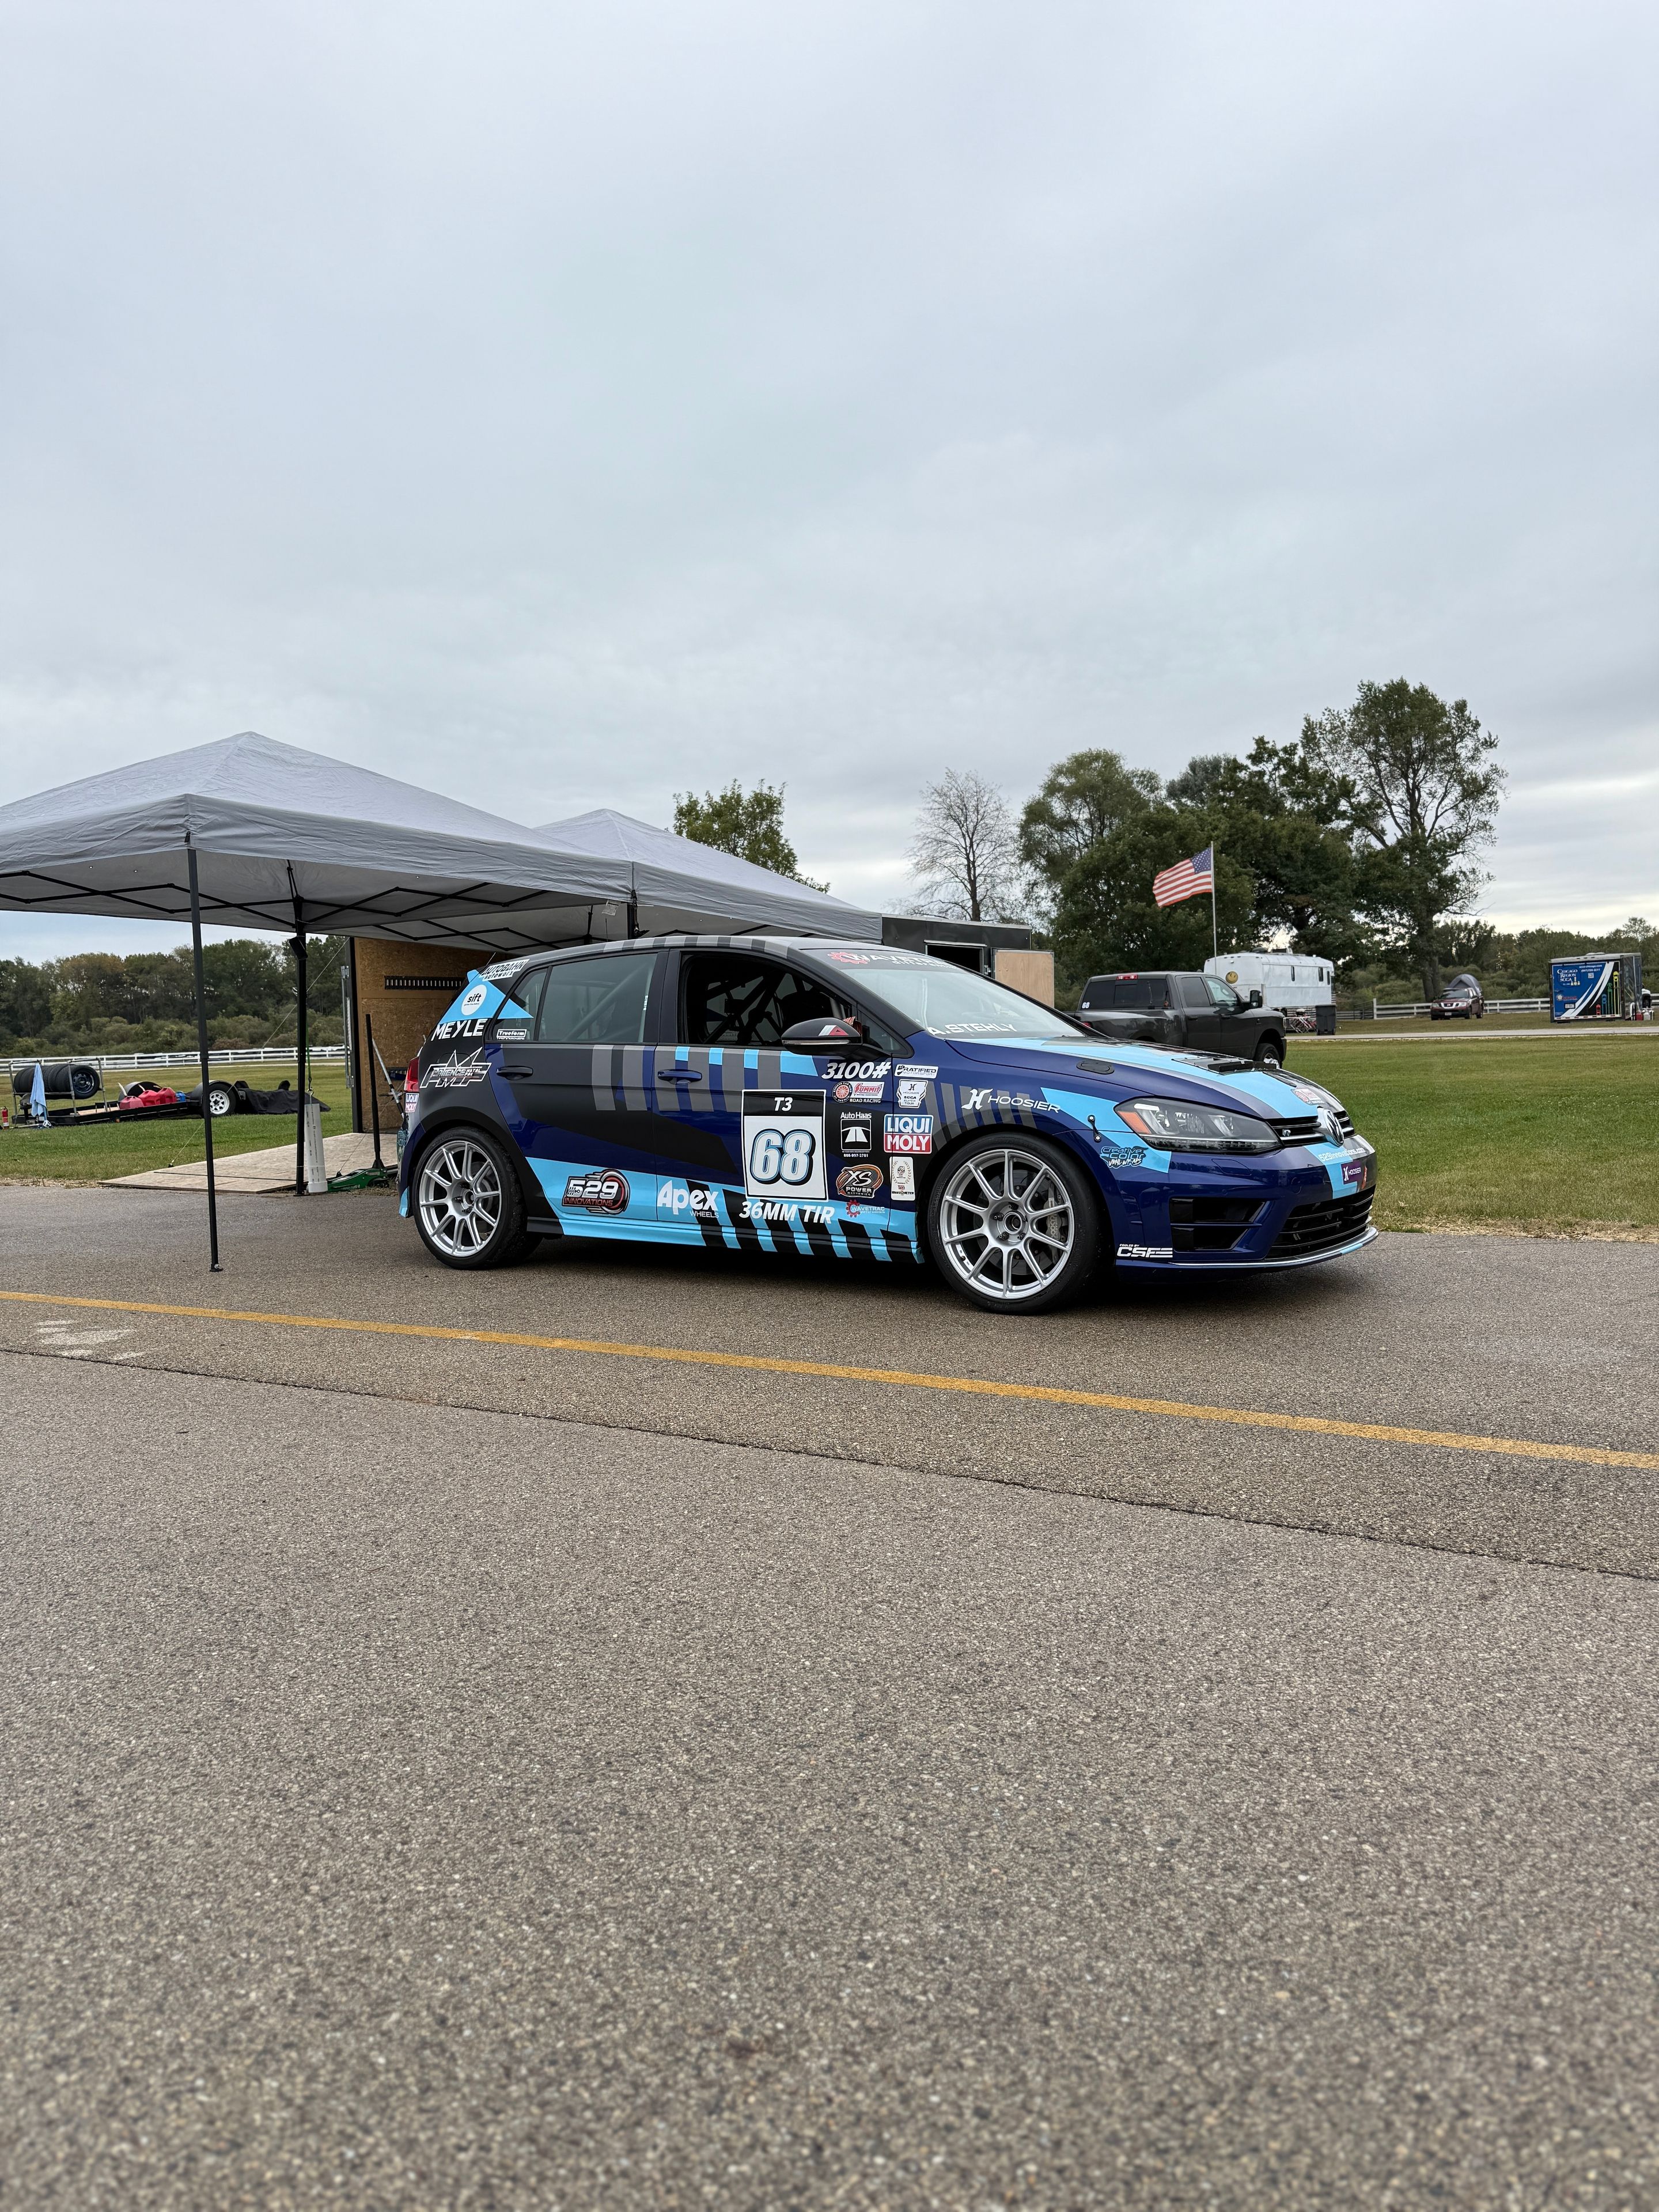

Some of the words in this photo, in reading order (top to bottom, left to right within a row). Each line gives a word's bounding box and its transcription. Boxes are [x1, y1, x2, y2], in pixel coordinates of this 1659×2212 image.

[467, 993, 482, 1002] sift
[431, 1018, 488, 1041] MEYLE
[927, 1023, 1017, 1036] A.STEHLY
[821, 1062, 891, 1080] 3100#
[854, 1083, 882, 1096] SUMMIT
[774, 1097, 793, 1111] T3
[987, 1096, 1060, 1113] HOOSIER
[887, 1117, 930, 1134] LIQUI
[887, 1135, 931, 1151] MOLY
[750, 1128, 816, 1185] 68
[841, 1170, 872, 1187] XS
[566, 1180, 619, 1199] 529
[657, 1180, 719, 1215] Apex
[565, 1198, 613, 1206] INNOVATIONS
[690, 1210, 719, 1218] WHEELS
[739, 1201, 798, 1221] 36MM
[802, 1205, 835, 1224] TIR
